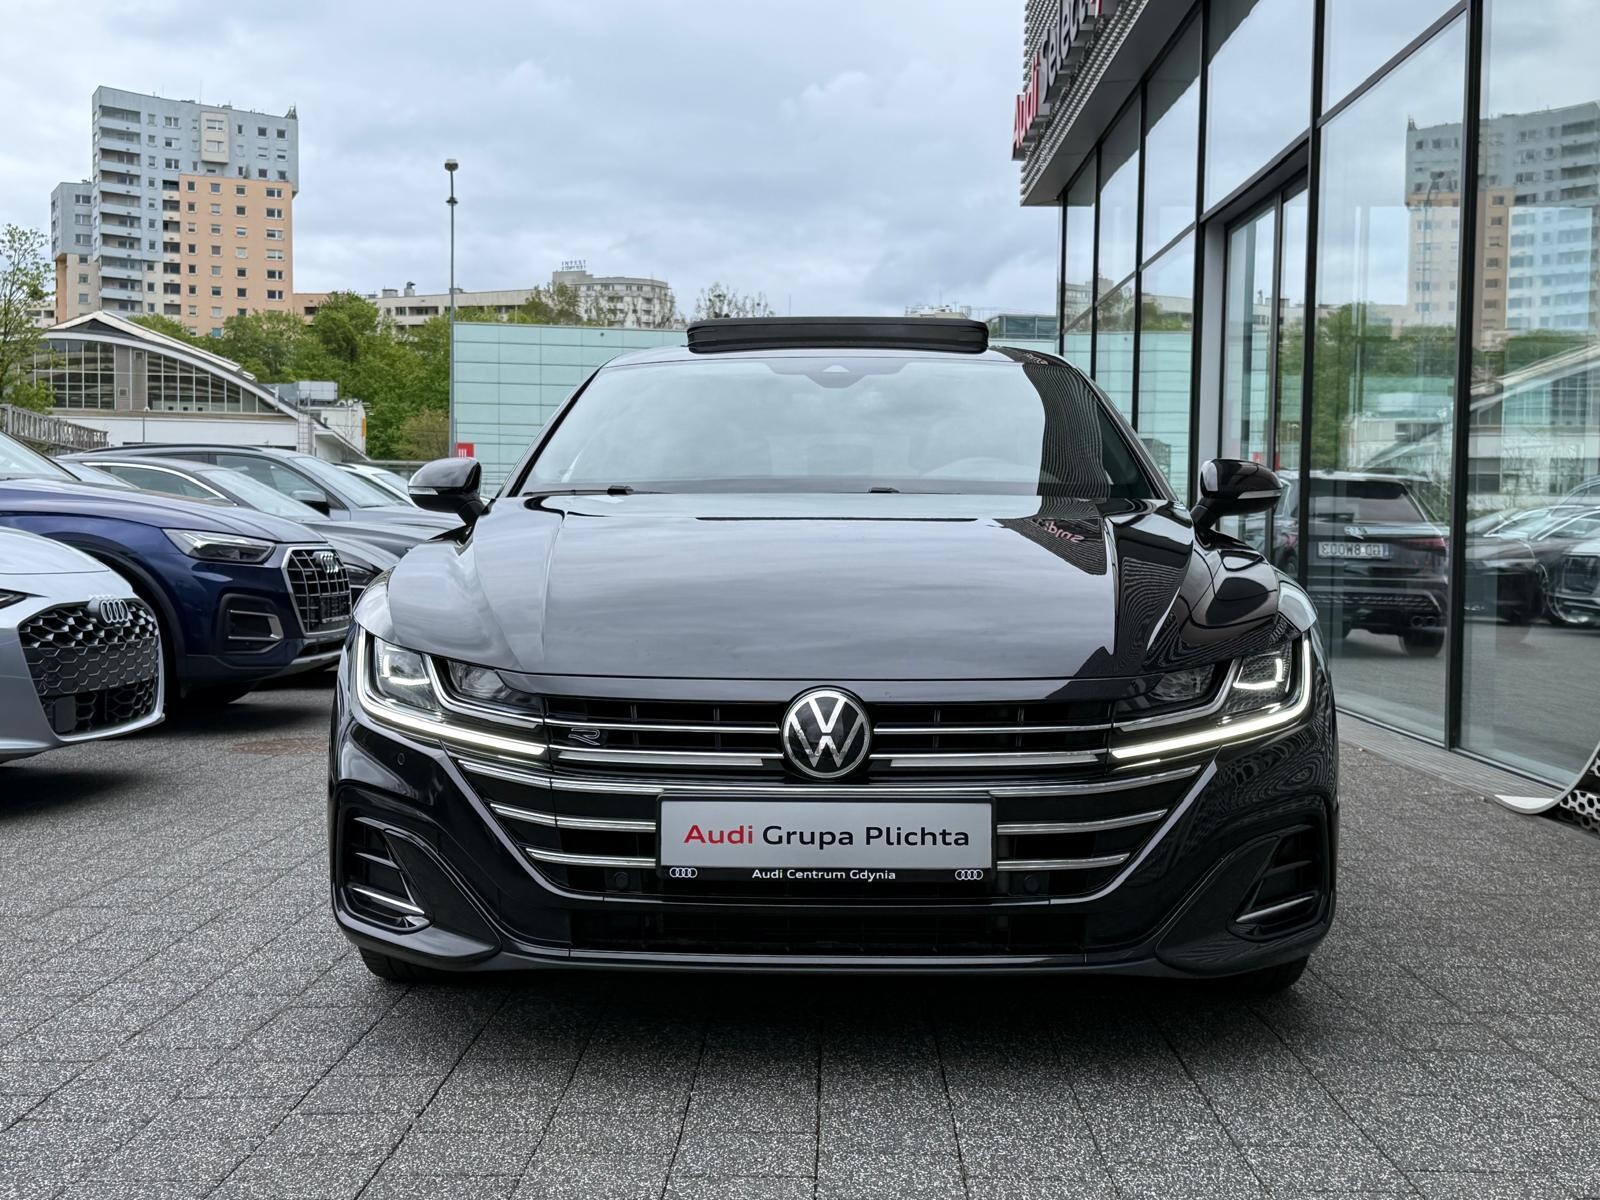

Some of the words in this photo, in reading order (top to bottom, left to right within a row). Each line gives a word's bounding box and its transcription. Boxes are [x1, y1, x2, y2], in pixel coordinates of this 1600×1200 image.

[1013, 51, 1041, 149] Audi
[684, 825, 753, 844] Audi
[763, 826, 854, 850] Grupa
[866, 827, 969, 846] Plichta
[752, 869, 783, 879] Audi
[787, 869, 846, 880] Centrum
[850, 869, 896, 882] Gdynia
